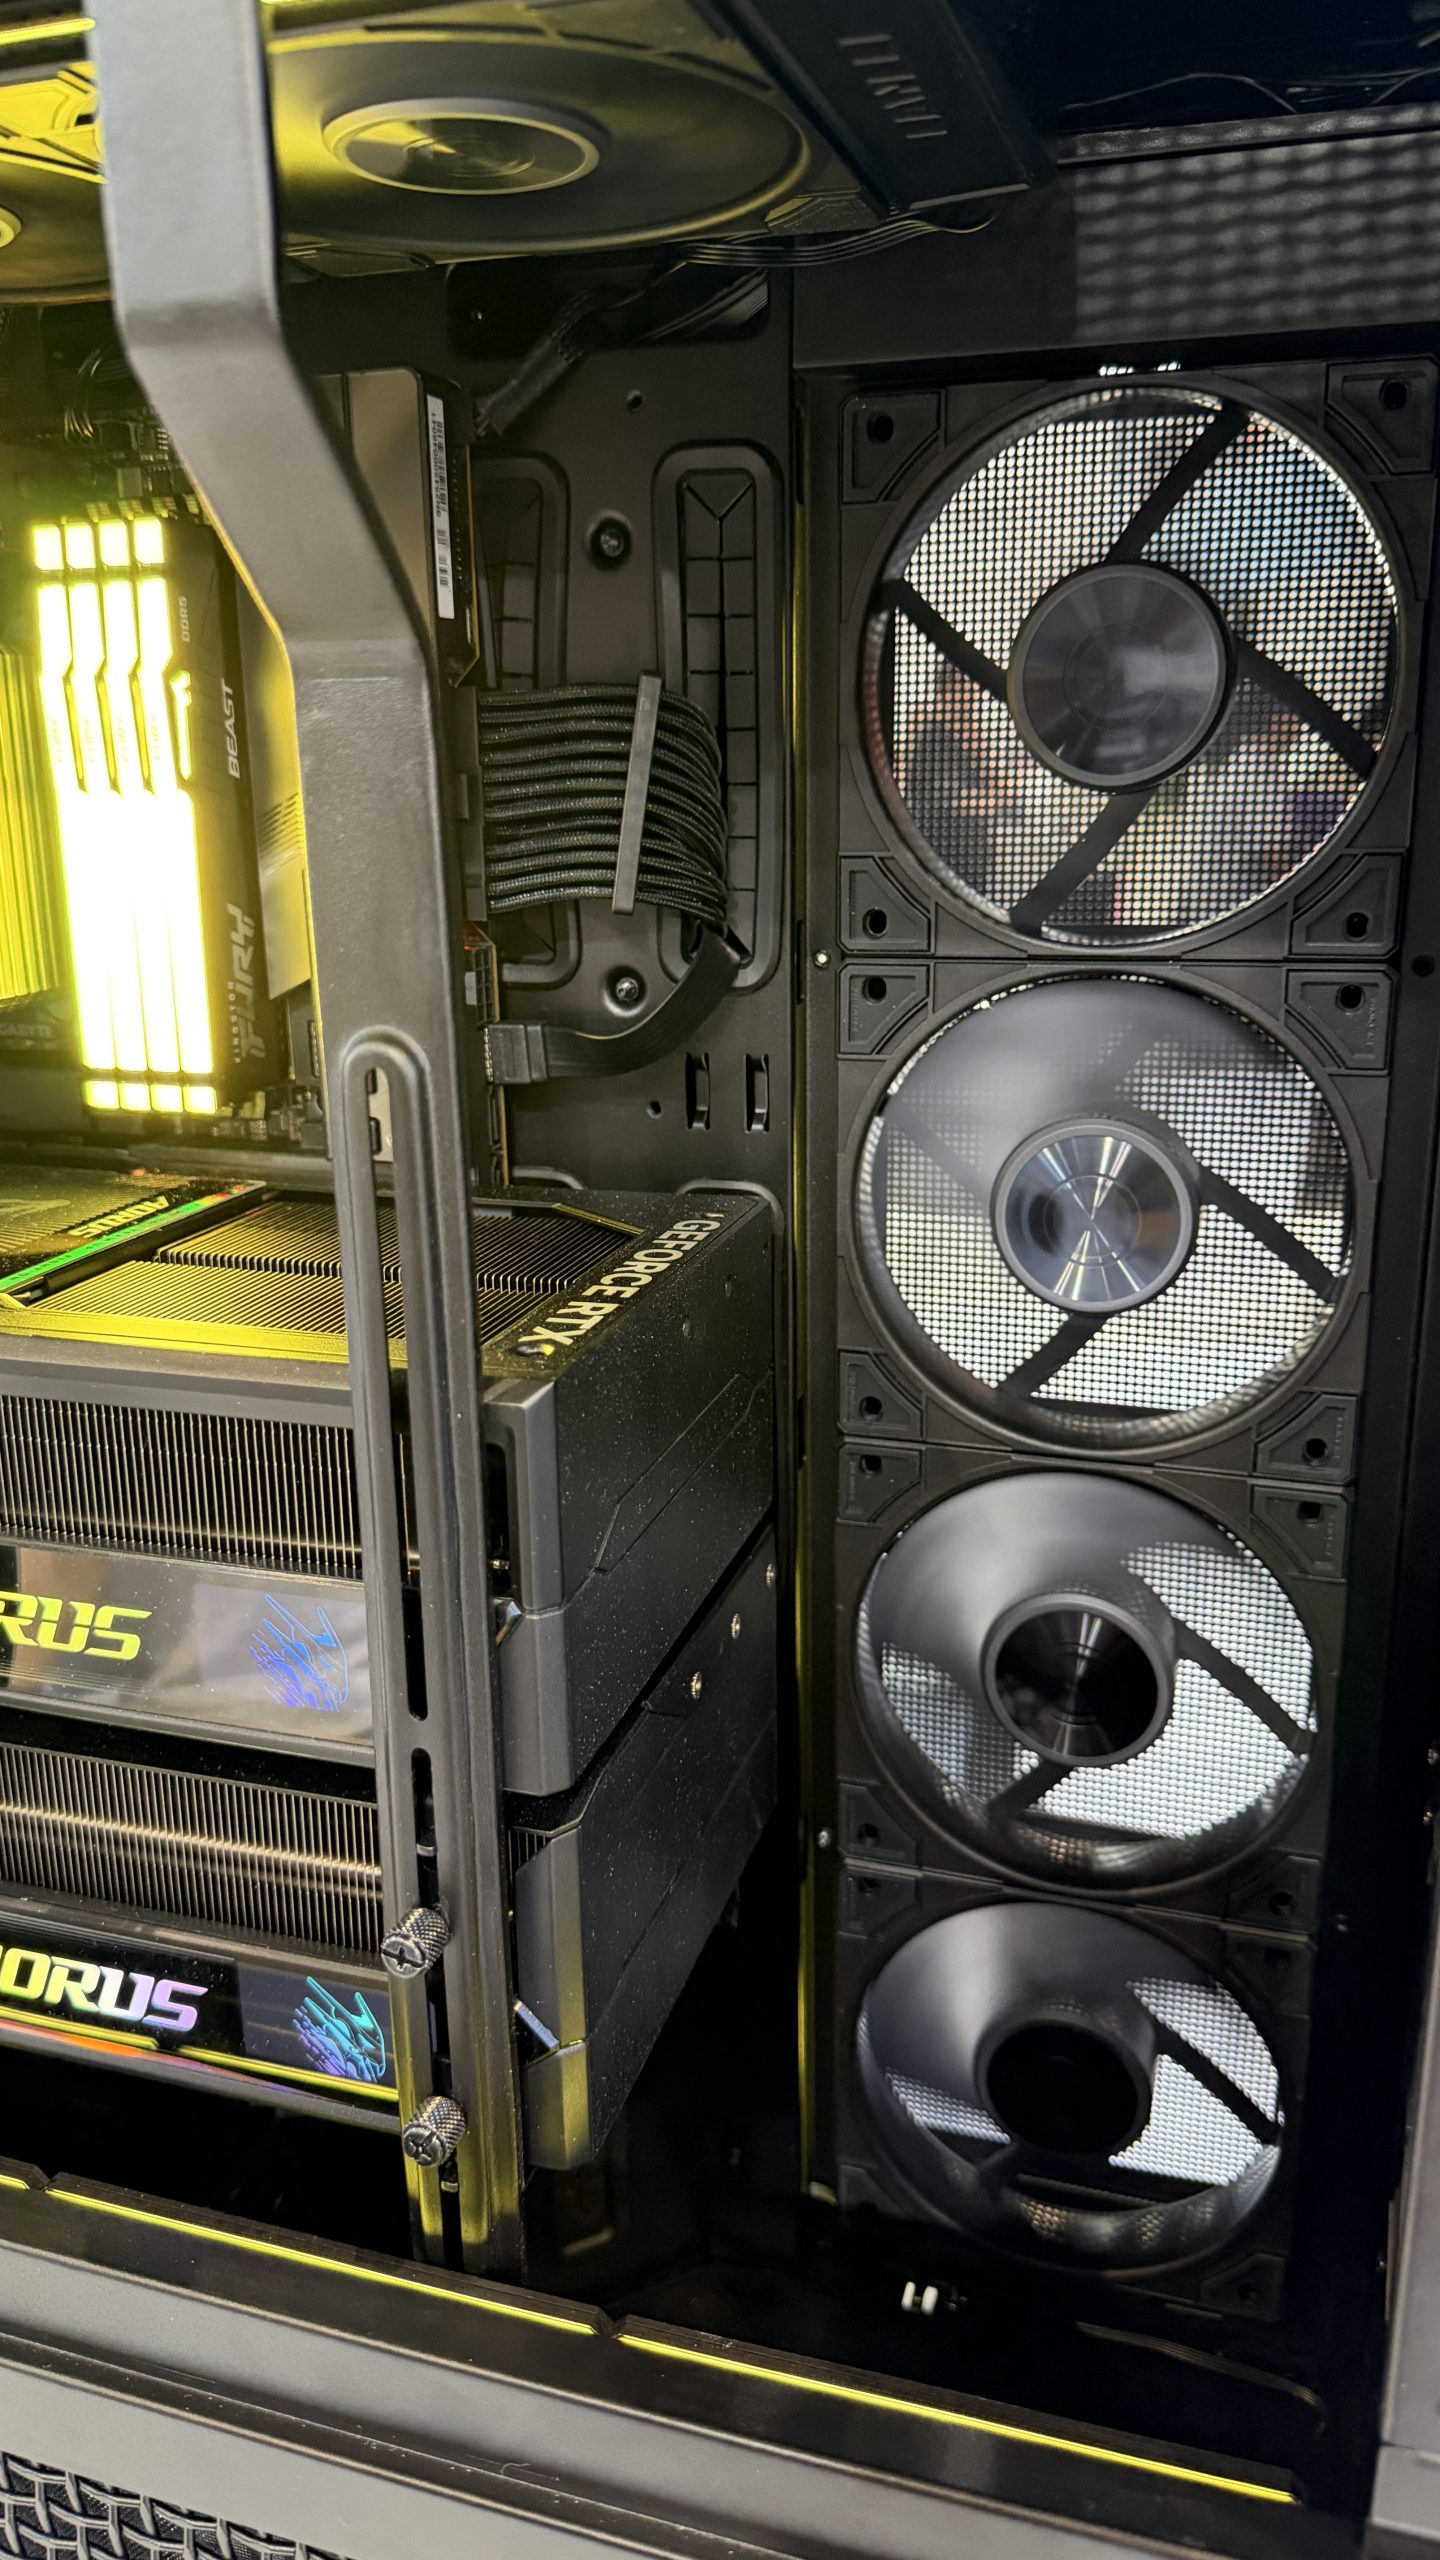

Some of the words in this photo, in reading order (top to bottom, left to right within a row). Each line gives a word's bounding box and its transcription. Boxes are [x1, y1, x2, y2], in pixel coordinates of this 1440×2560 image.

[179, 596, 191, 643] DDR5
[221, 677, 241, 779] BEAST
[227, 903, 267, 1059] FURY
[67, 1195, 171, 1239] AORUS
[581, 1218, 722, 1300] GEFORCE
[517, 1301, 621, 1346] RTX
[0, 1945, 209, 2033] ORUS
